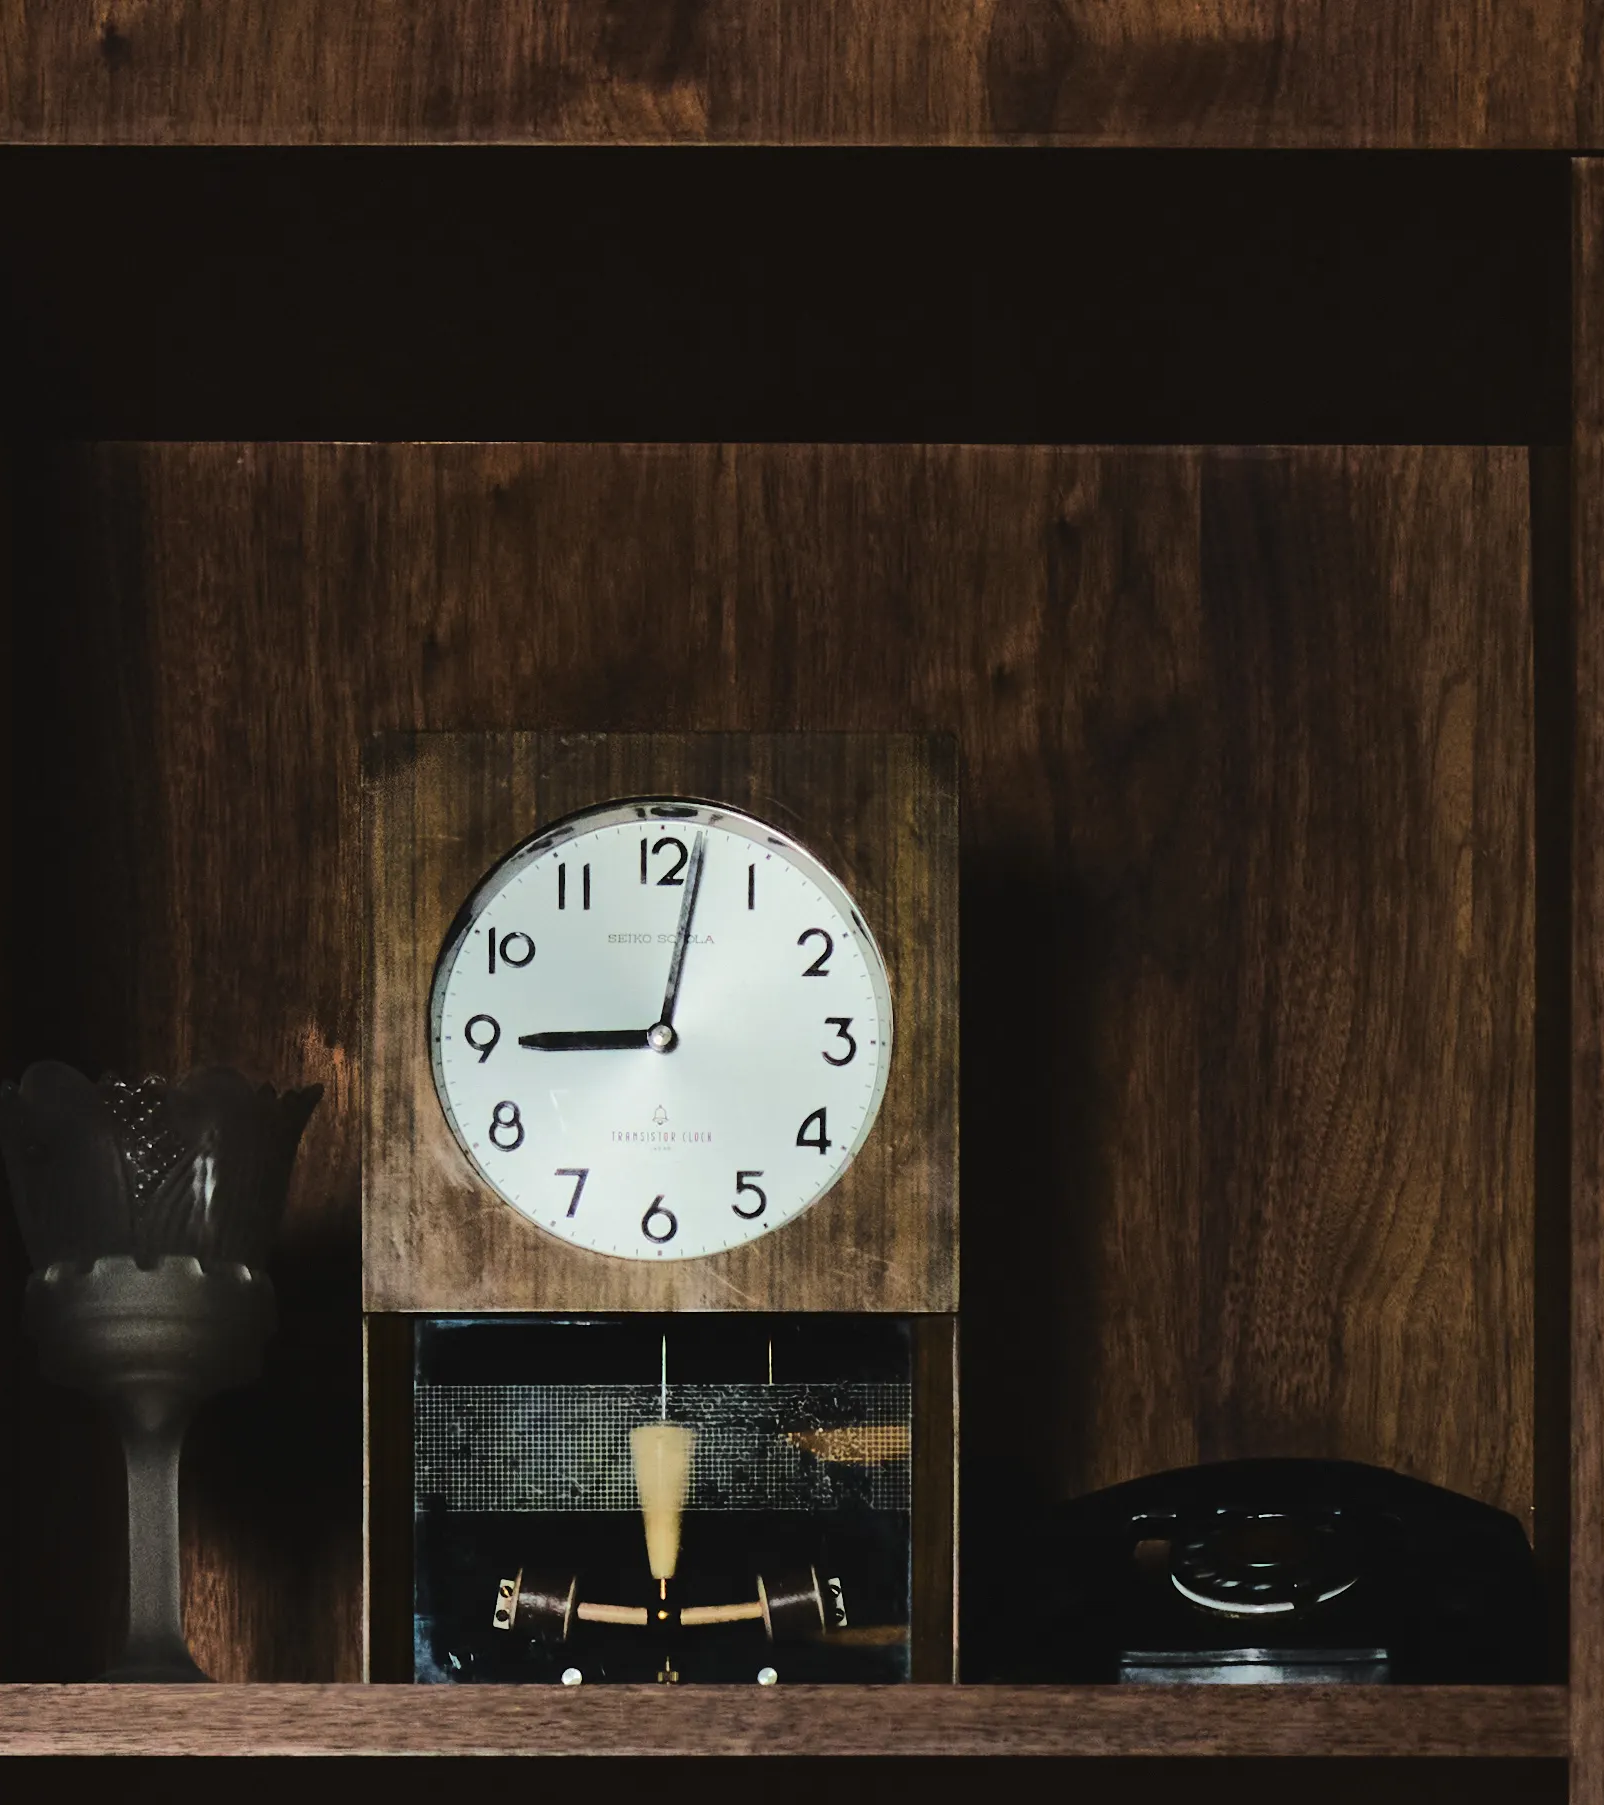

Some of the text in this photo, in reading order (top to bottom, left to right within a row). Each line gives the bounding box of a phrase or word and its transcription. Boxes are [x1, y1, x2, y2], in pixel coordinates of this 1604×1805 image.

[640, 836, 689, 886] 12
[557, 862, 592, 911] 11
[747, 862, 756, 911] 1
[488, 926, 536, 975] 10
[607, 933, 715, 944] SEIKO SOOLA
[796, 927, 835, 977] 2
[463, 1013, 501, 1064] 9
[821, 1017, 857, 1067] 3
[488, 1100, 525, 1153] 8
[612, 1130, 712, 1142] TRANSISTOR CLOCK
[795, 1106, 833, 1156] 4
[554, 1167, 590, 1218] 7
[731, 1170, 768, 1220] 5
[640, 1194, 678, 1244] 6
